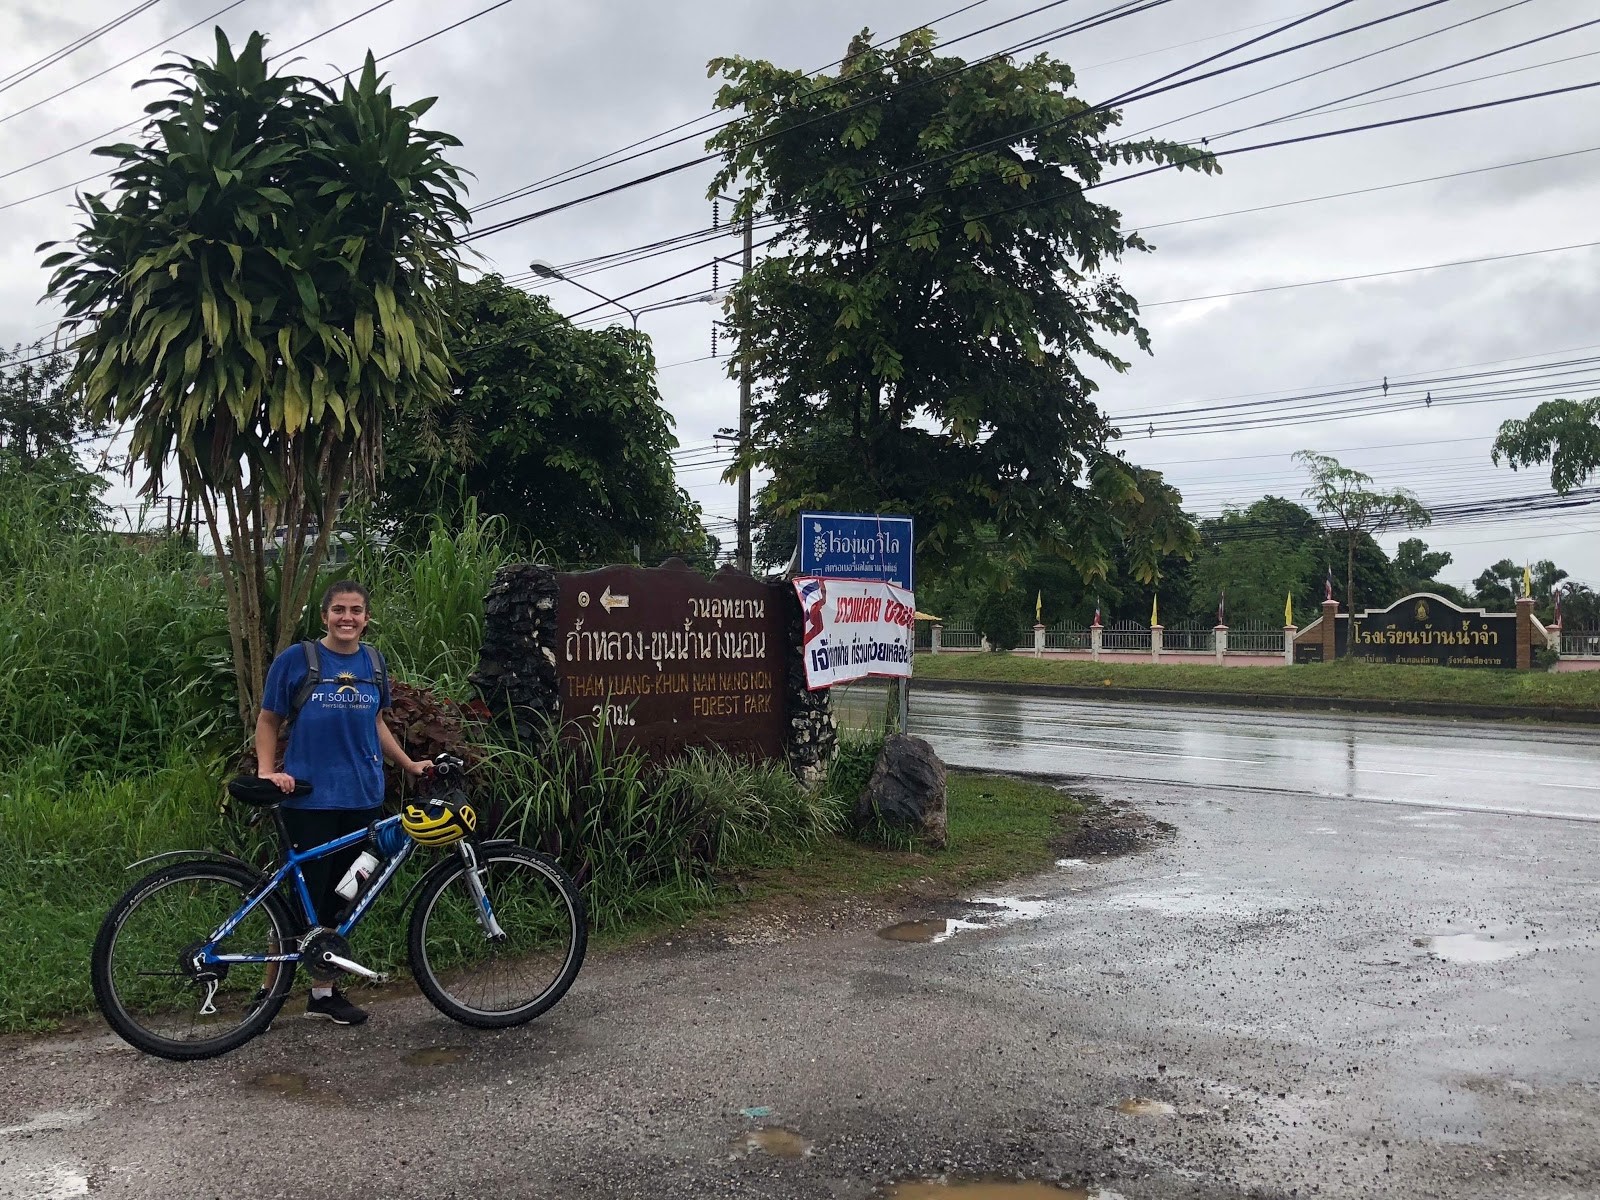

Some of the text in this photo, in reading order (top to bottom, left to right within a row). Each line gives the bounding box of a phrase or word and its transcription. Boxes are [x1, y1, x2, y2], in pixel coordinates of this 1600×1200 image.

[687, 598, 765, 628] วนอุทยาน
[566, 617, 766, 671] ถ้ำหลวง-ขุนน้ำนางนอน
[1353, 620, 1498, 645] โรงเรียนบ้านน้ำจำ
[567, 674, 604, 697] THAM
[693, 672, 716, 692] NAM
[719, 671, 748, 691] NANG
[750, 671, 772, 690] NON
[311, 692, 325, 702] PT
[693, 693, 772, 716] FOREST PARK
